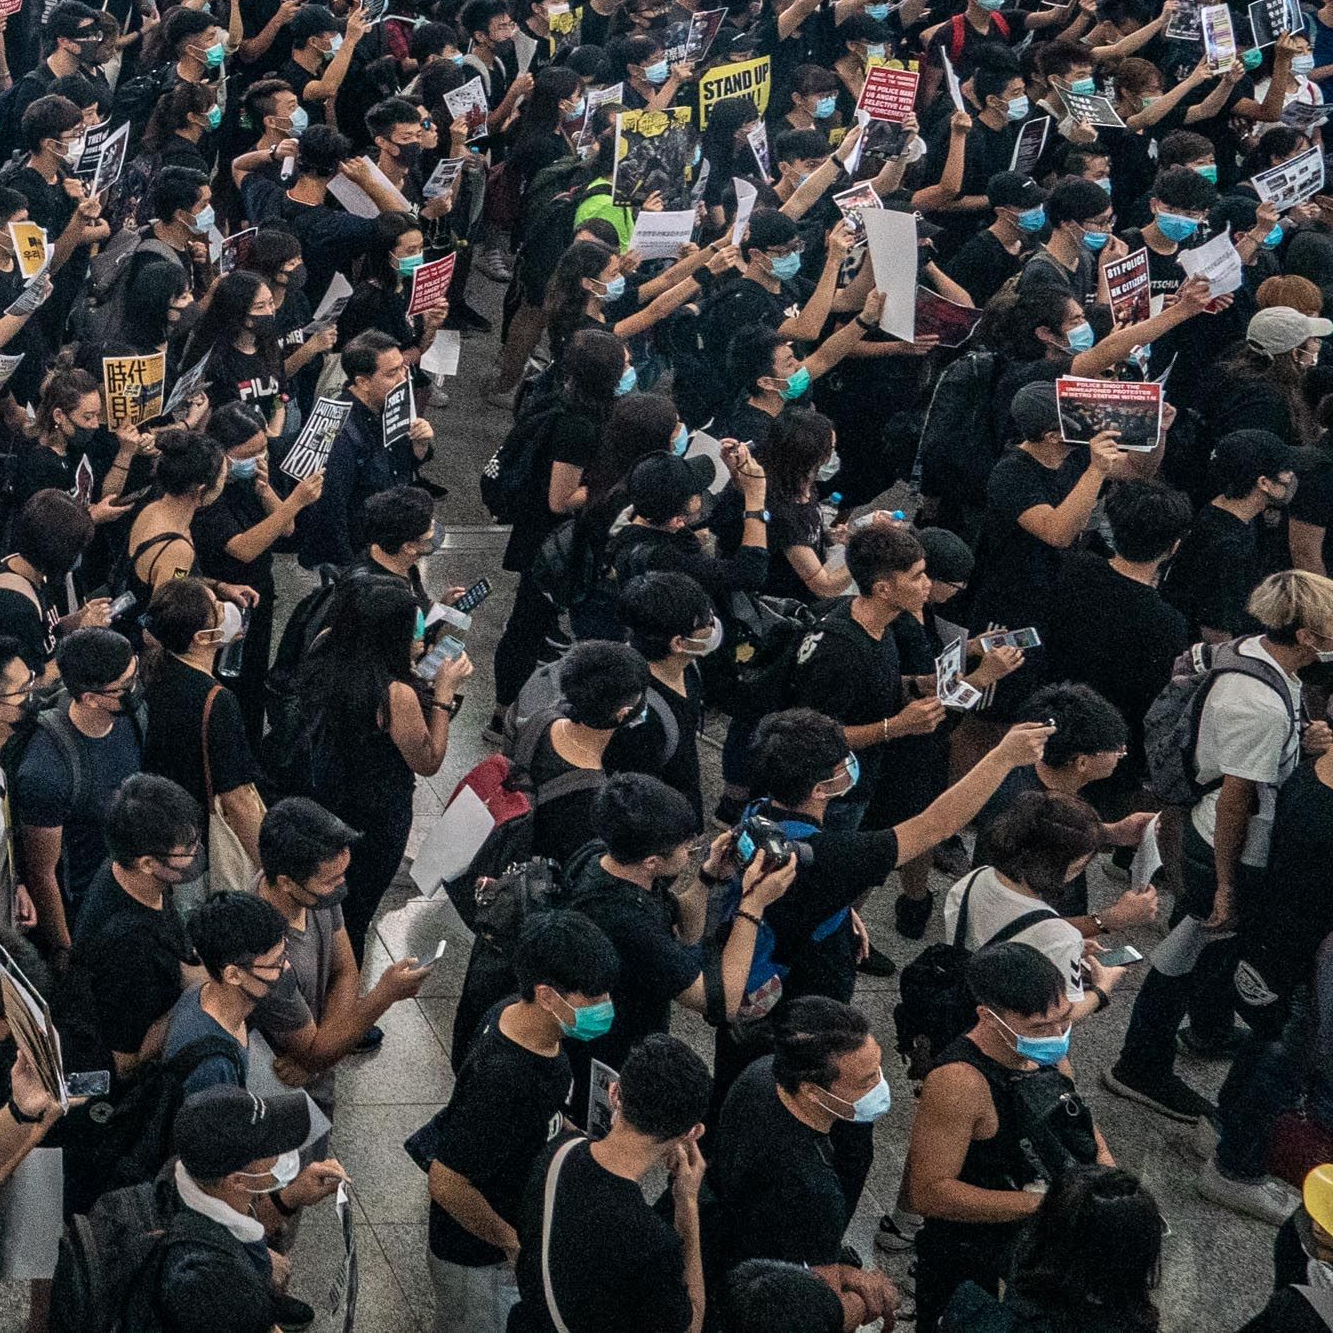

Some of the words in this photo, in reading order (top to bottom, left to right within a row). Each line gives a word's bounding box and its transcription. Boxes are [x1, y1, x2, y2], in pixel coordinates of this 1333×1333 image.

[703, 70, 752, 101] STAND
[755, 63, 769, 85] UP
[877, 86, 899, 95] POLICE
[899, 89, 914, 97] MAKE
[864, 97, 898, 110] SELECTIVE
[898, 103, 910, 111] LAW
[876, 92, 898, 102] ANGRY
[898, 96, 913, 104] WITH
[1106, 265, 1121, 279] 811
[1121, 253, 1146, 273] POLICE
[1110, 287, 1121, 298] HK
[1121, 272, 1147, 292] CITIZENS
[107, 359, 146, 394] 時代
[237, 375, 279, 402] FILA
[297, 413, 340, 453] HONG
